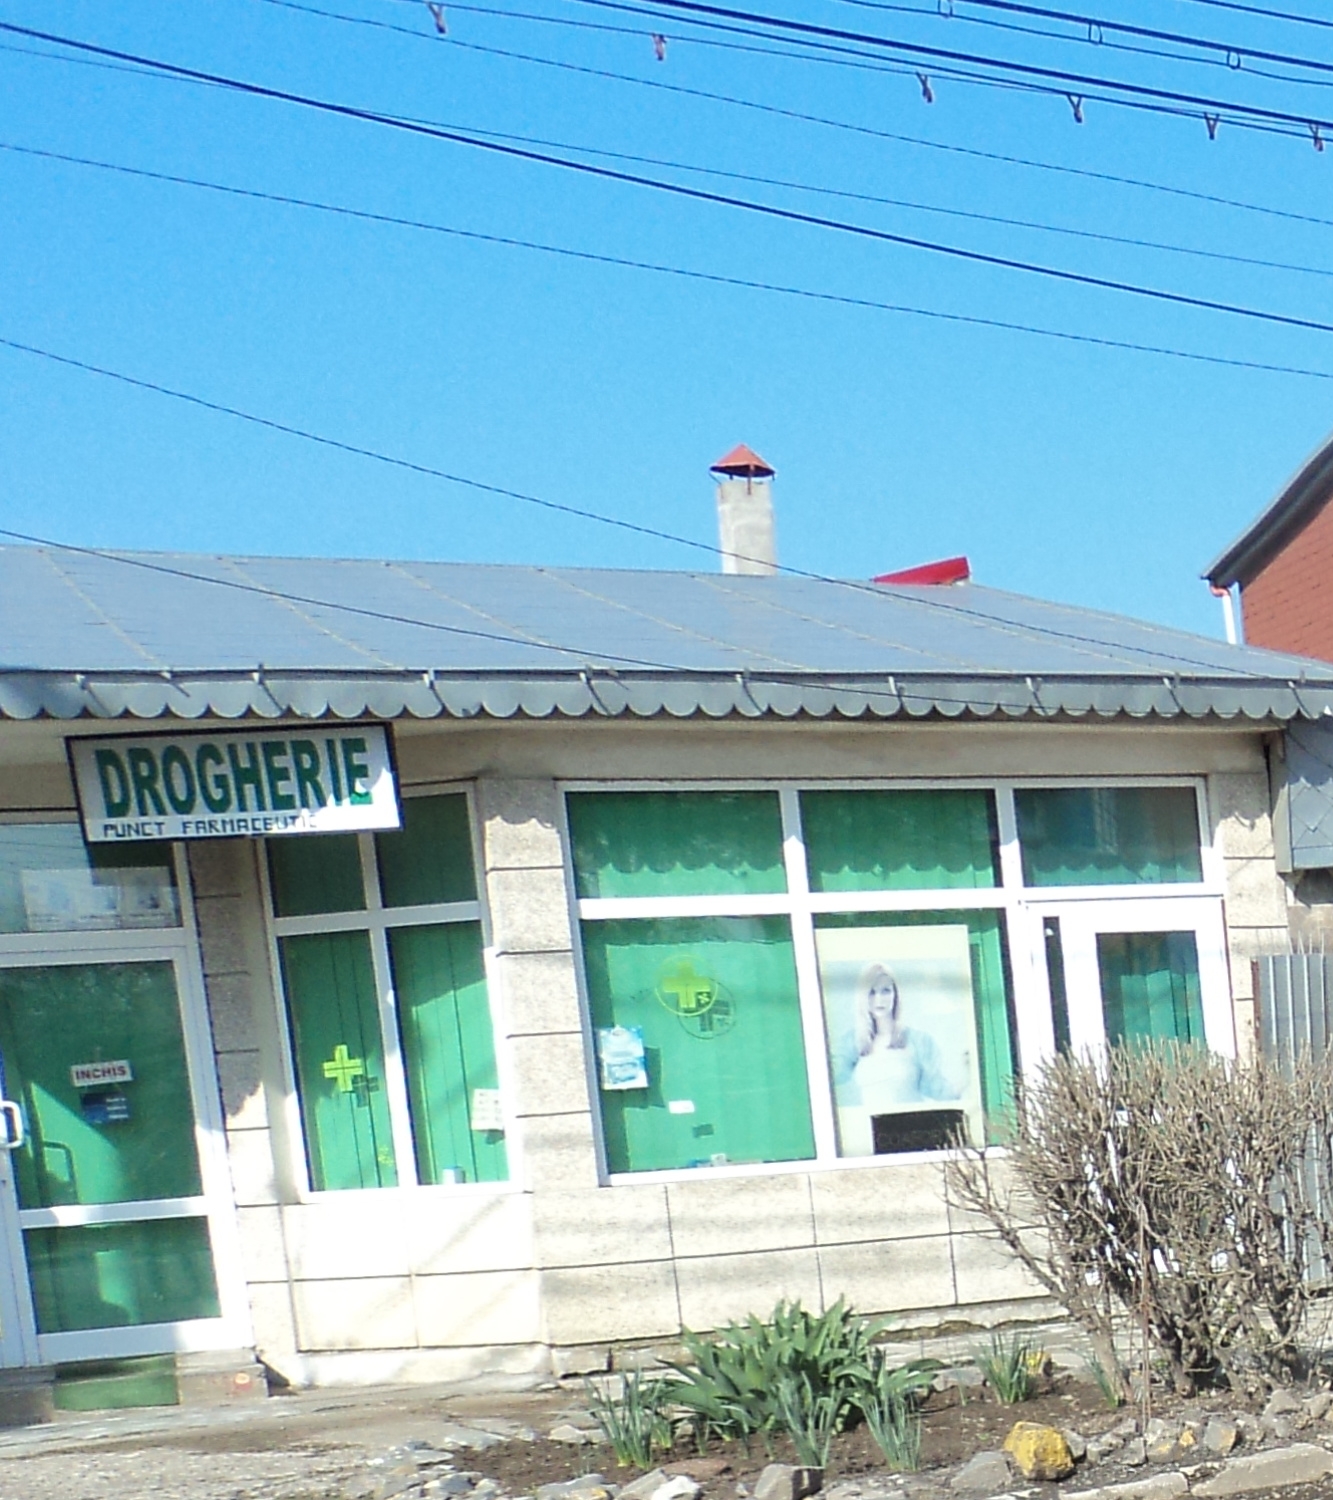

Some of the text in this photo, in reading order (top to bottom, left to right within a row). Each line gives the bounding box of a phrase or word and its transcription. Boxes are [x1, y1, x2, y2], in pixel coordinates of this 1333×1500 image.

[95, 737, 374, 819] DROGHERIE
[103, 821, 166, 839] PUNCT
[76, 1065, 127, 1080] INCHIS
